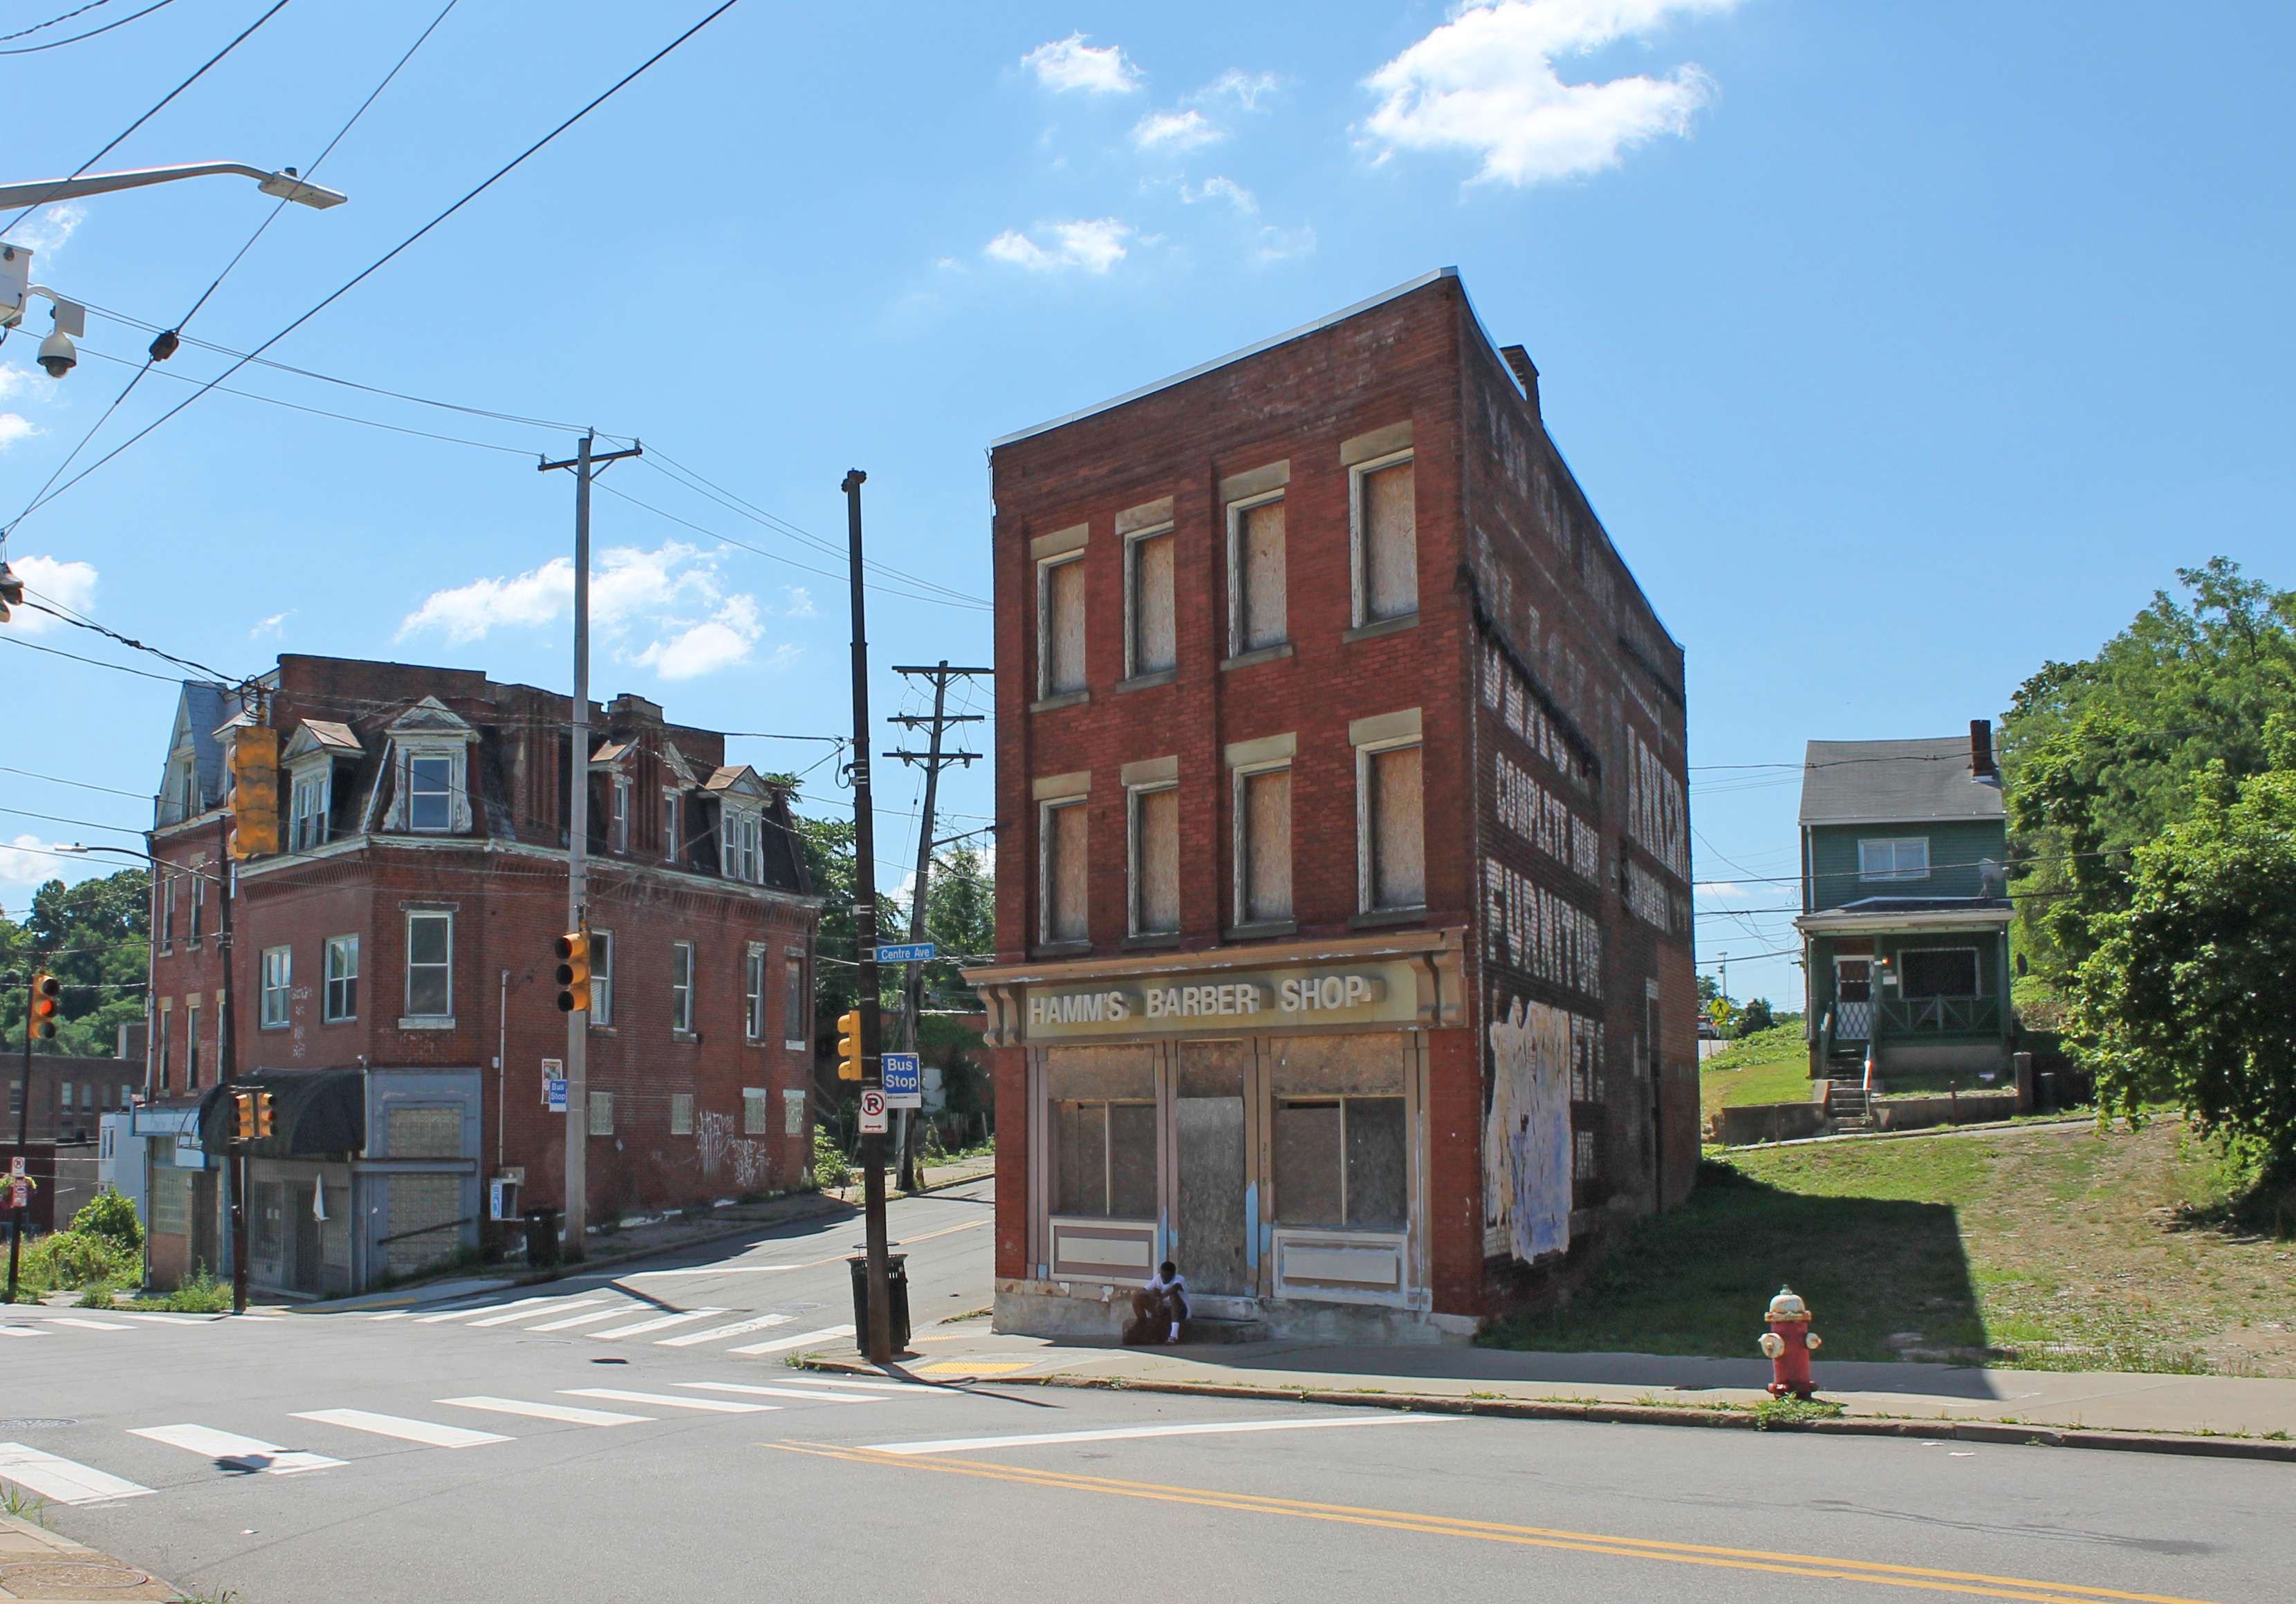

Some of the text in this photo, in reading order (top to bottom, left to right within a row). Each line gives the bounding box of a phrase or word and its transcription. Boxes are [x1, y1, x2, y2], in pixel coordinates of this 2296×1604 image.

[1496, 749, 1568, 864] COMPLETE
[881, 947, 930, 960] Centre Ave
[1030, 976, 1365, 1025] HAMM'S BARBER SHOP
[887, 1058, 914, 1071] Bus
[886, 1074, 917, 1090] Stop
[550, 1092, 566, 1101] Stop
